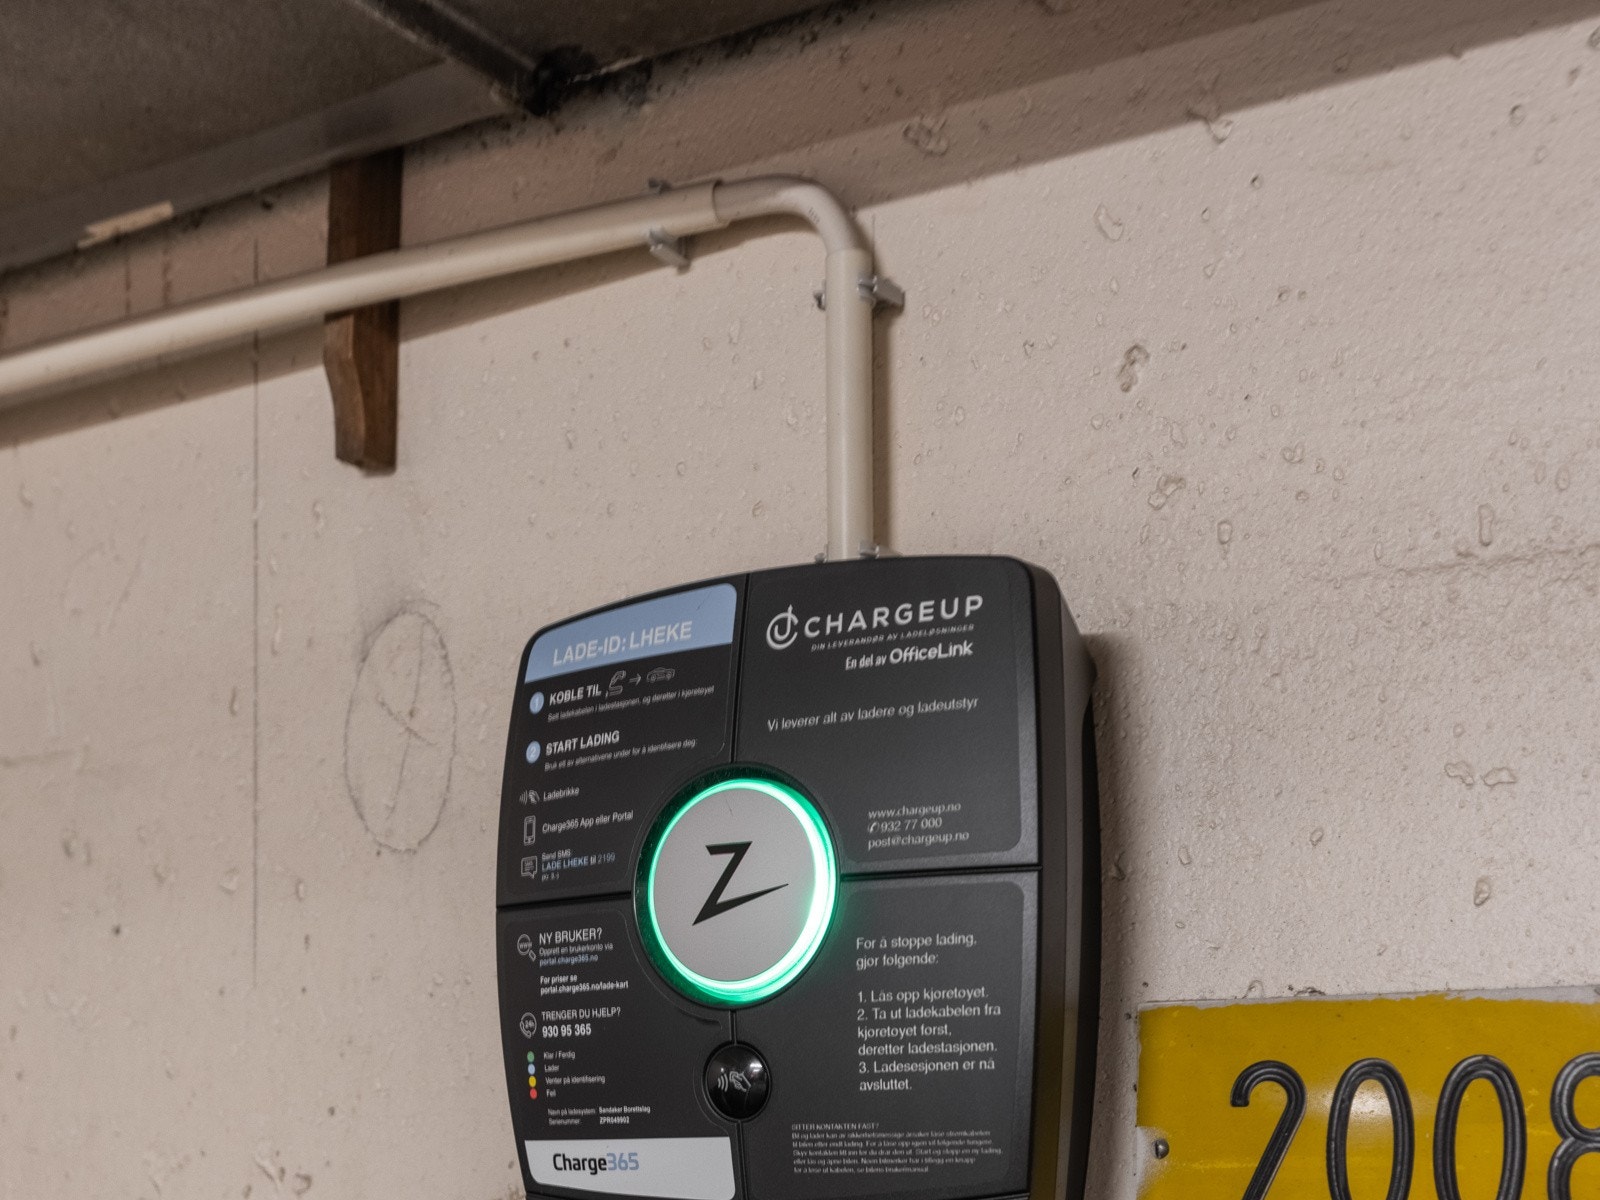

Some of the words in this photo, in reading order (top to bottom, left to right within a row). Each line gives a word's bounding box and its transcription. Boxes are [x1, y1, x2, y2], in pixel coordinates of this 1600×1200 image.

[804, 594, 983, 638] CHARGEUP
[553, 635, 626, 667] LADE-ID:
[629, 621, 693, 650] LHEKE
[886, 632, 899, 641] AV
[845, 656, 857, 670] En
[859, 653, 874, 669] del
[875, 655, 887, 666] av
[889, 640, 974, 664] OfficeLink
[550, 686, 584, 706] KOBLE
[586, 684, 602, 698] TIL
[767, 718, 779, 732] Vi
[782, 714, 821, 729] leverer
[823, 710, 837, 724] alt
[840, 711, 855, 722] av
[857, 705, 895, 721] ladere
[898, 703, 915, 719] og
[917, 697, 980, 714] ladeutstyr
[546, 738, 578, 756] START
[580, 730, 620, 749] LADING
[543, 787, 580, 801] Ladebrikke
[868, 803, 961, 819] www.chargeup.no
[542, 818, 579, 834] Charge365
[580, 817, 594, 829] App
[612, 810, 634, 823] Portal
[880, 820, 901, 833] 932
[904, 818, 918, 831] 77
[920, 816, 943, 829] 000
[868, 831, 970, 851] post@chargeup.no
[542, 860, 561, 872] LADE
[563, 856, 589, 869] LHEKE
[540, 931, 553, 945] NY
[555, 927, 603, 944] BRUKER?
[856, 937, 876, 950] For
[891, 935, 933, 950] stoppe
[540, 975, 550, 985] For
[551, 974, 569, 985] priser
[871, 988, 893, 1003] Lås
[896, 990, 920, 1004] opp
[541, 1009, 577, 1021] TRENGER
[579, 1008, 590, 1020] DU
[591, 1006, 621, 1018] HJELP?
[857, 1008, 868, 1021] 2.
[872, 1007, 887, 1020] Ta
[890, 1007, 902, 1020] ut
[905, 1004, 981, 1019] ladekabelen
[984, 1003, 1001, 1016] fra
[542, 1025, 559, 1038] 930
[560, 1024, 572, 1037] 95
[574, 1023, 592, 1036] 365
[858, 1043, 905, 1056] deretter
[908, 1040, 998, 1056] ladestasjonen.
[858, 1061, 870, 1074] 3.
[873, 1060, 959, 1075] Ladesesjonen
[962, 1060, 976, 1071] er
[979, 1057, 996, 1071] nå
[859, 1078, 913, 1092] avsluttet.
[553, 1152, 640, 1176] Charge365
